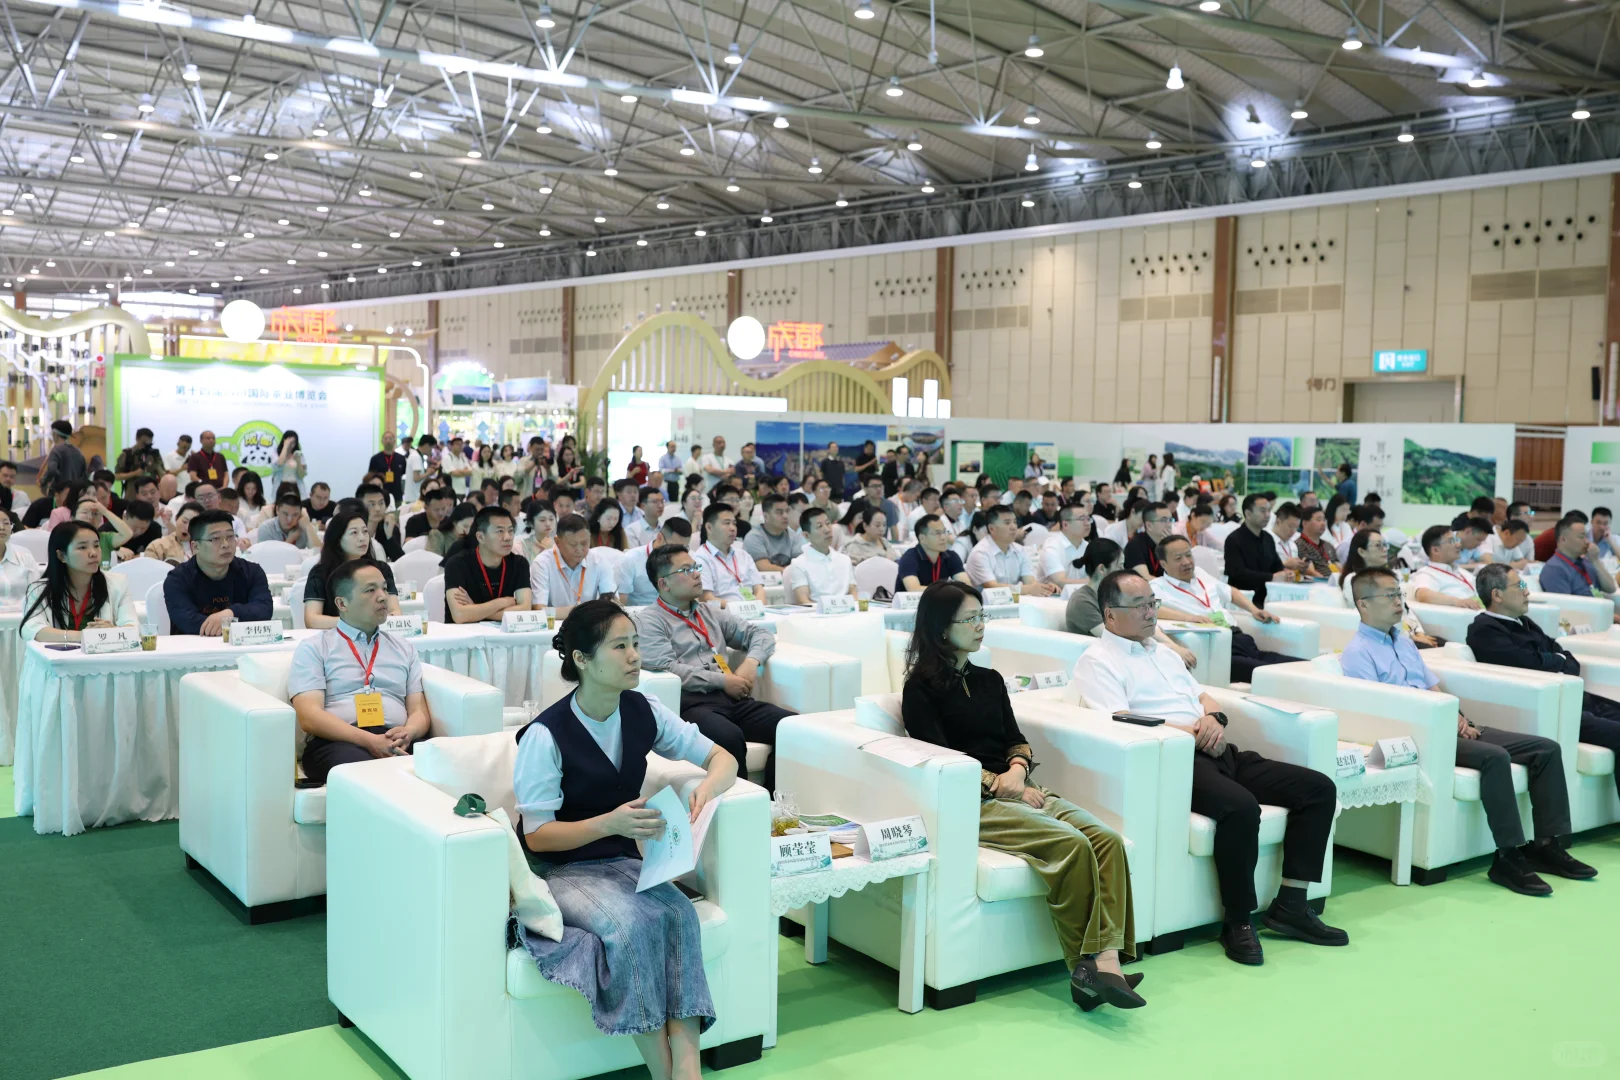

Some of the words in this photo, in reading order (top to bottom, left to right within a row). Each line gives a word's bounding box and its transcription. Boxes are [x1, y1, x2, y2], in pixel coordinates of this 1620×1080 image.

[270, 305, 338, 344] 成都
[768, 320, 824, 362] 成都
[245, 625, 272, 636] 李传辉
[880, 823, 913, 841] 周晓琴
[779, 840, 817, 858] 顾莹莹
